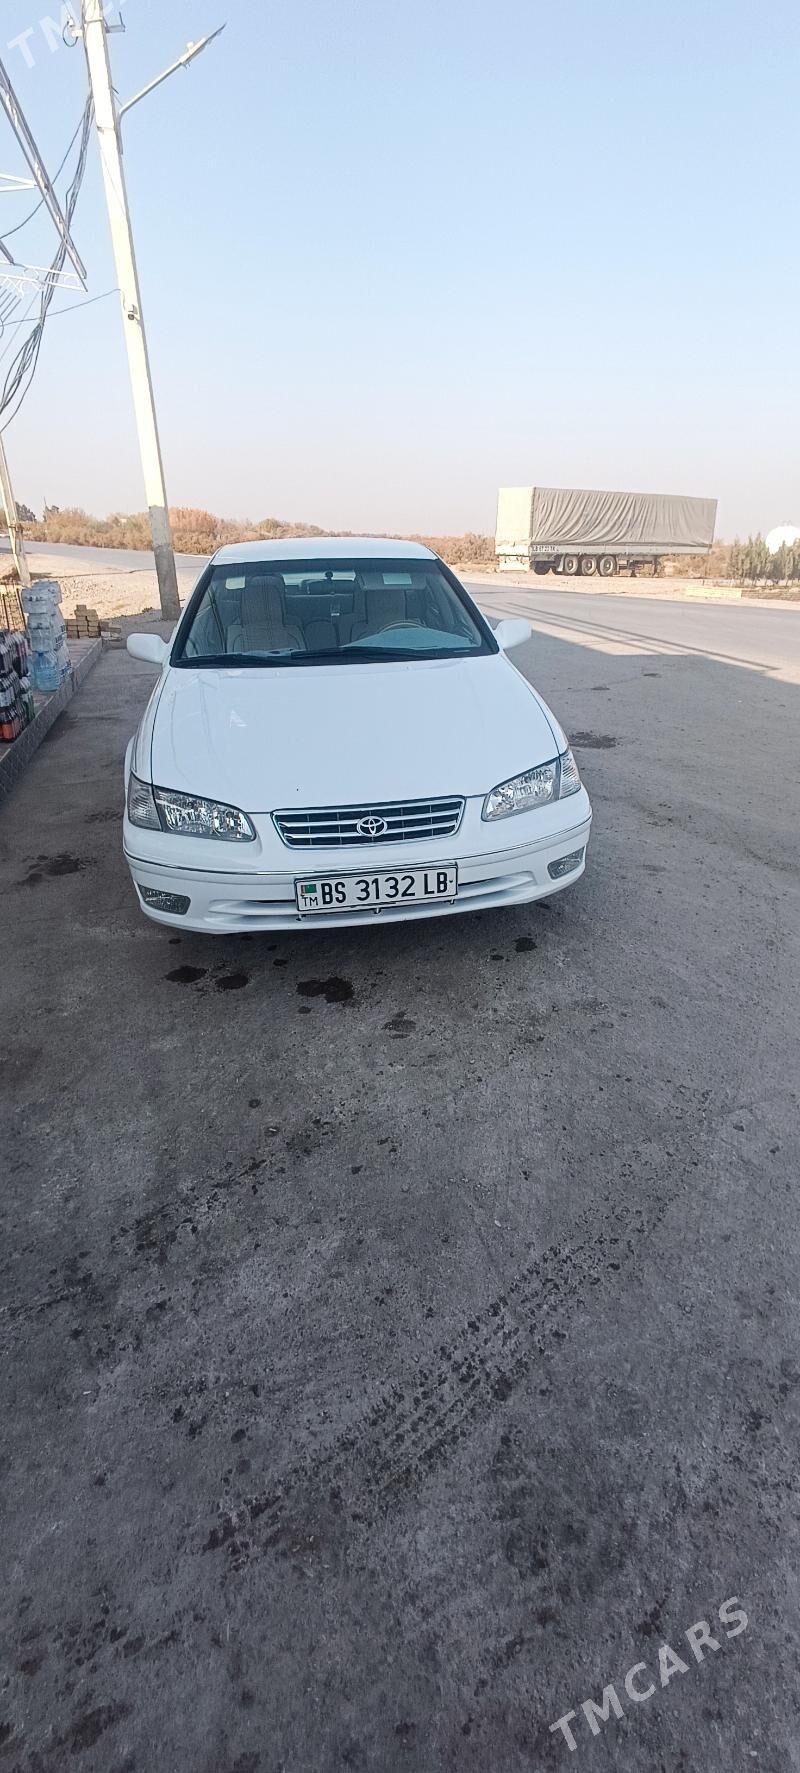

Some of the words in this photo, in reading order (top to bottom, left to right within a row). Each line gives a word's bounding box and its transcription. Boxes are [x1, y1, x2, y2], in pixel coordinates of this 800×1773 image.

[321, 881, 347, 905] BS
[354, 876, 416, 902] 3132
[423, 871, 448, 895] LB
[302, 896, 317, 907] TM
